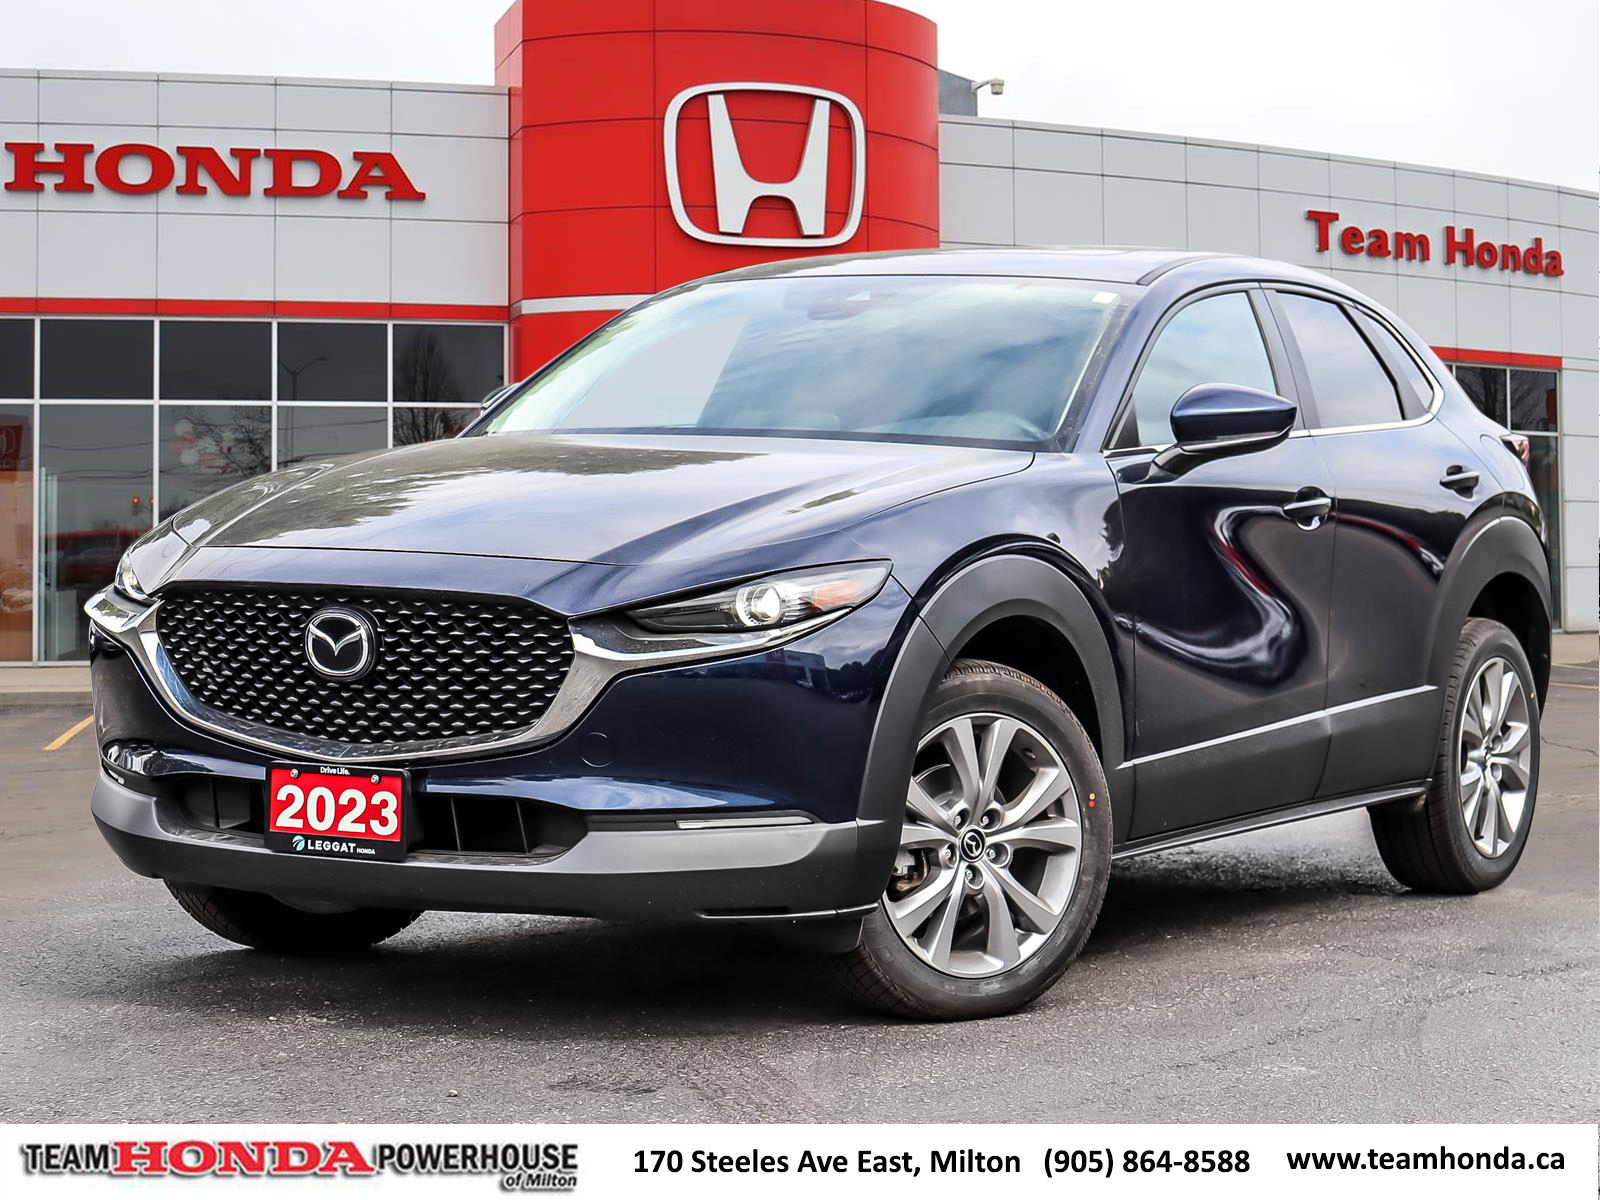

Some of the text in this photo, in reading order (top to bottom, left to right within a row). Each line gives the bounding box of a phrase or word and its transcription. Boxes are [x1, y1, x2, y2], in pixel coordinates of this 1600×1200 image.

[4, 142, 426, 201] HONDA
[1307, 210, 1564, 277] Team Honda
[320, 766, 336, 775] Drive
[275, 784, 398, 836] 2023
[307, 839, 356, 853] LEGGAT
